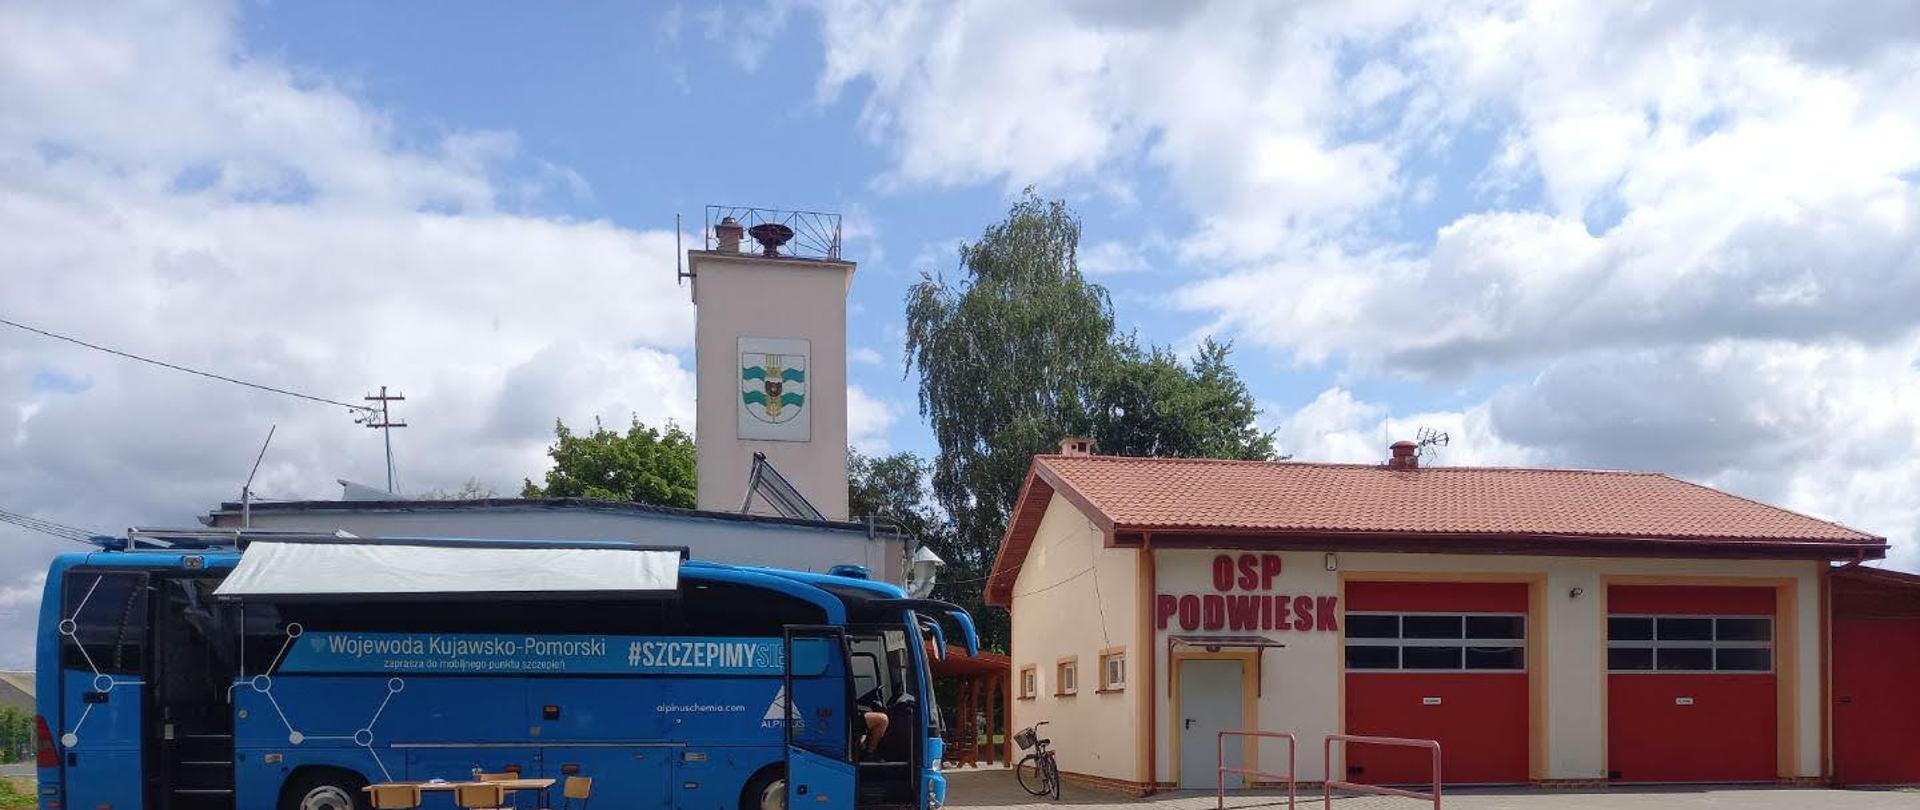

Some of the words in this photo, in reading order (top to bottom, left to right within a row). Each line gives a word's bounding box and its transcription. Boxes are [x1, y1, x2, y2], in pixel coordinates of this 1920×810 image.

[1212, 553, 1282, 592] OSP
[1157, 594, 1339, 632] PODWIESK
[329, 635, 424, 656] Wojewoda
[429, 637, 606, 658] Kujawsko-Pomorski
[384, 659, 424, 669] zaprasza
[426, 659, 437, 668] do
[489, 660, 520, 670] punktu
[656, 703, 746, 714] alpinuschemia.com
